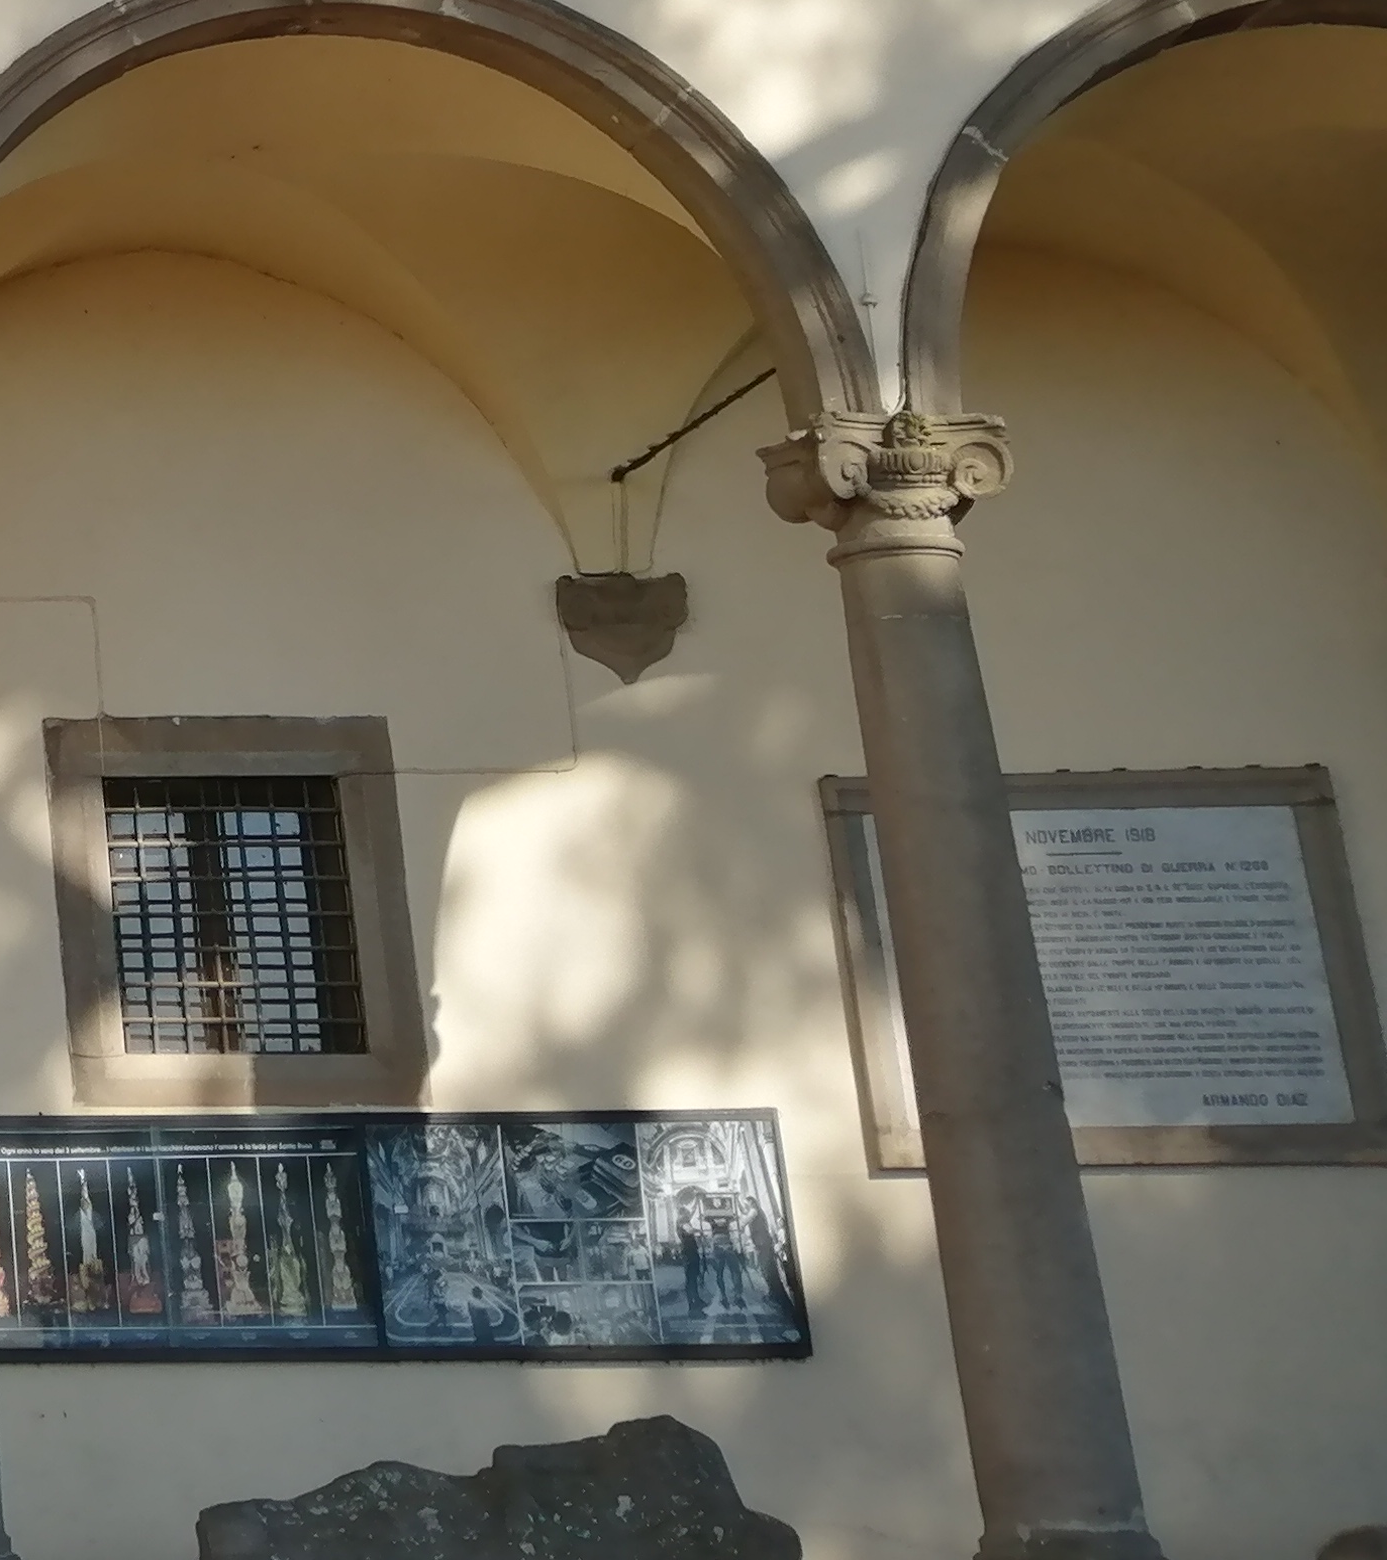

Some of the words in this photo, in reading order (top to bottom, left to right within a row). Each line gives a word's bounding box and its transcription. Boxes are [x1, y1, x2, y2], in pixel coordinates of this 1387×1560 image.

[1025, 828, 1116, 844] NOVEMBRE
[1124, 827, 1156, 842] 1918
[1046, 862, 1133, 875] BOLLETTINO
[1140, 862, 1153, 873] DI
[1161, 861, 1216, 872] GUERRA
[1202, 1092, 1269, 1107] ARMANDO
